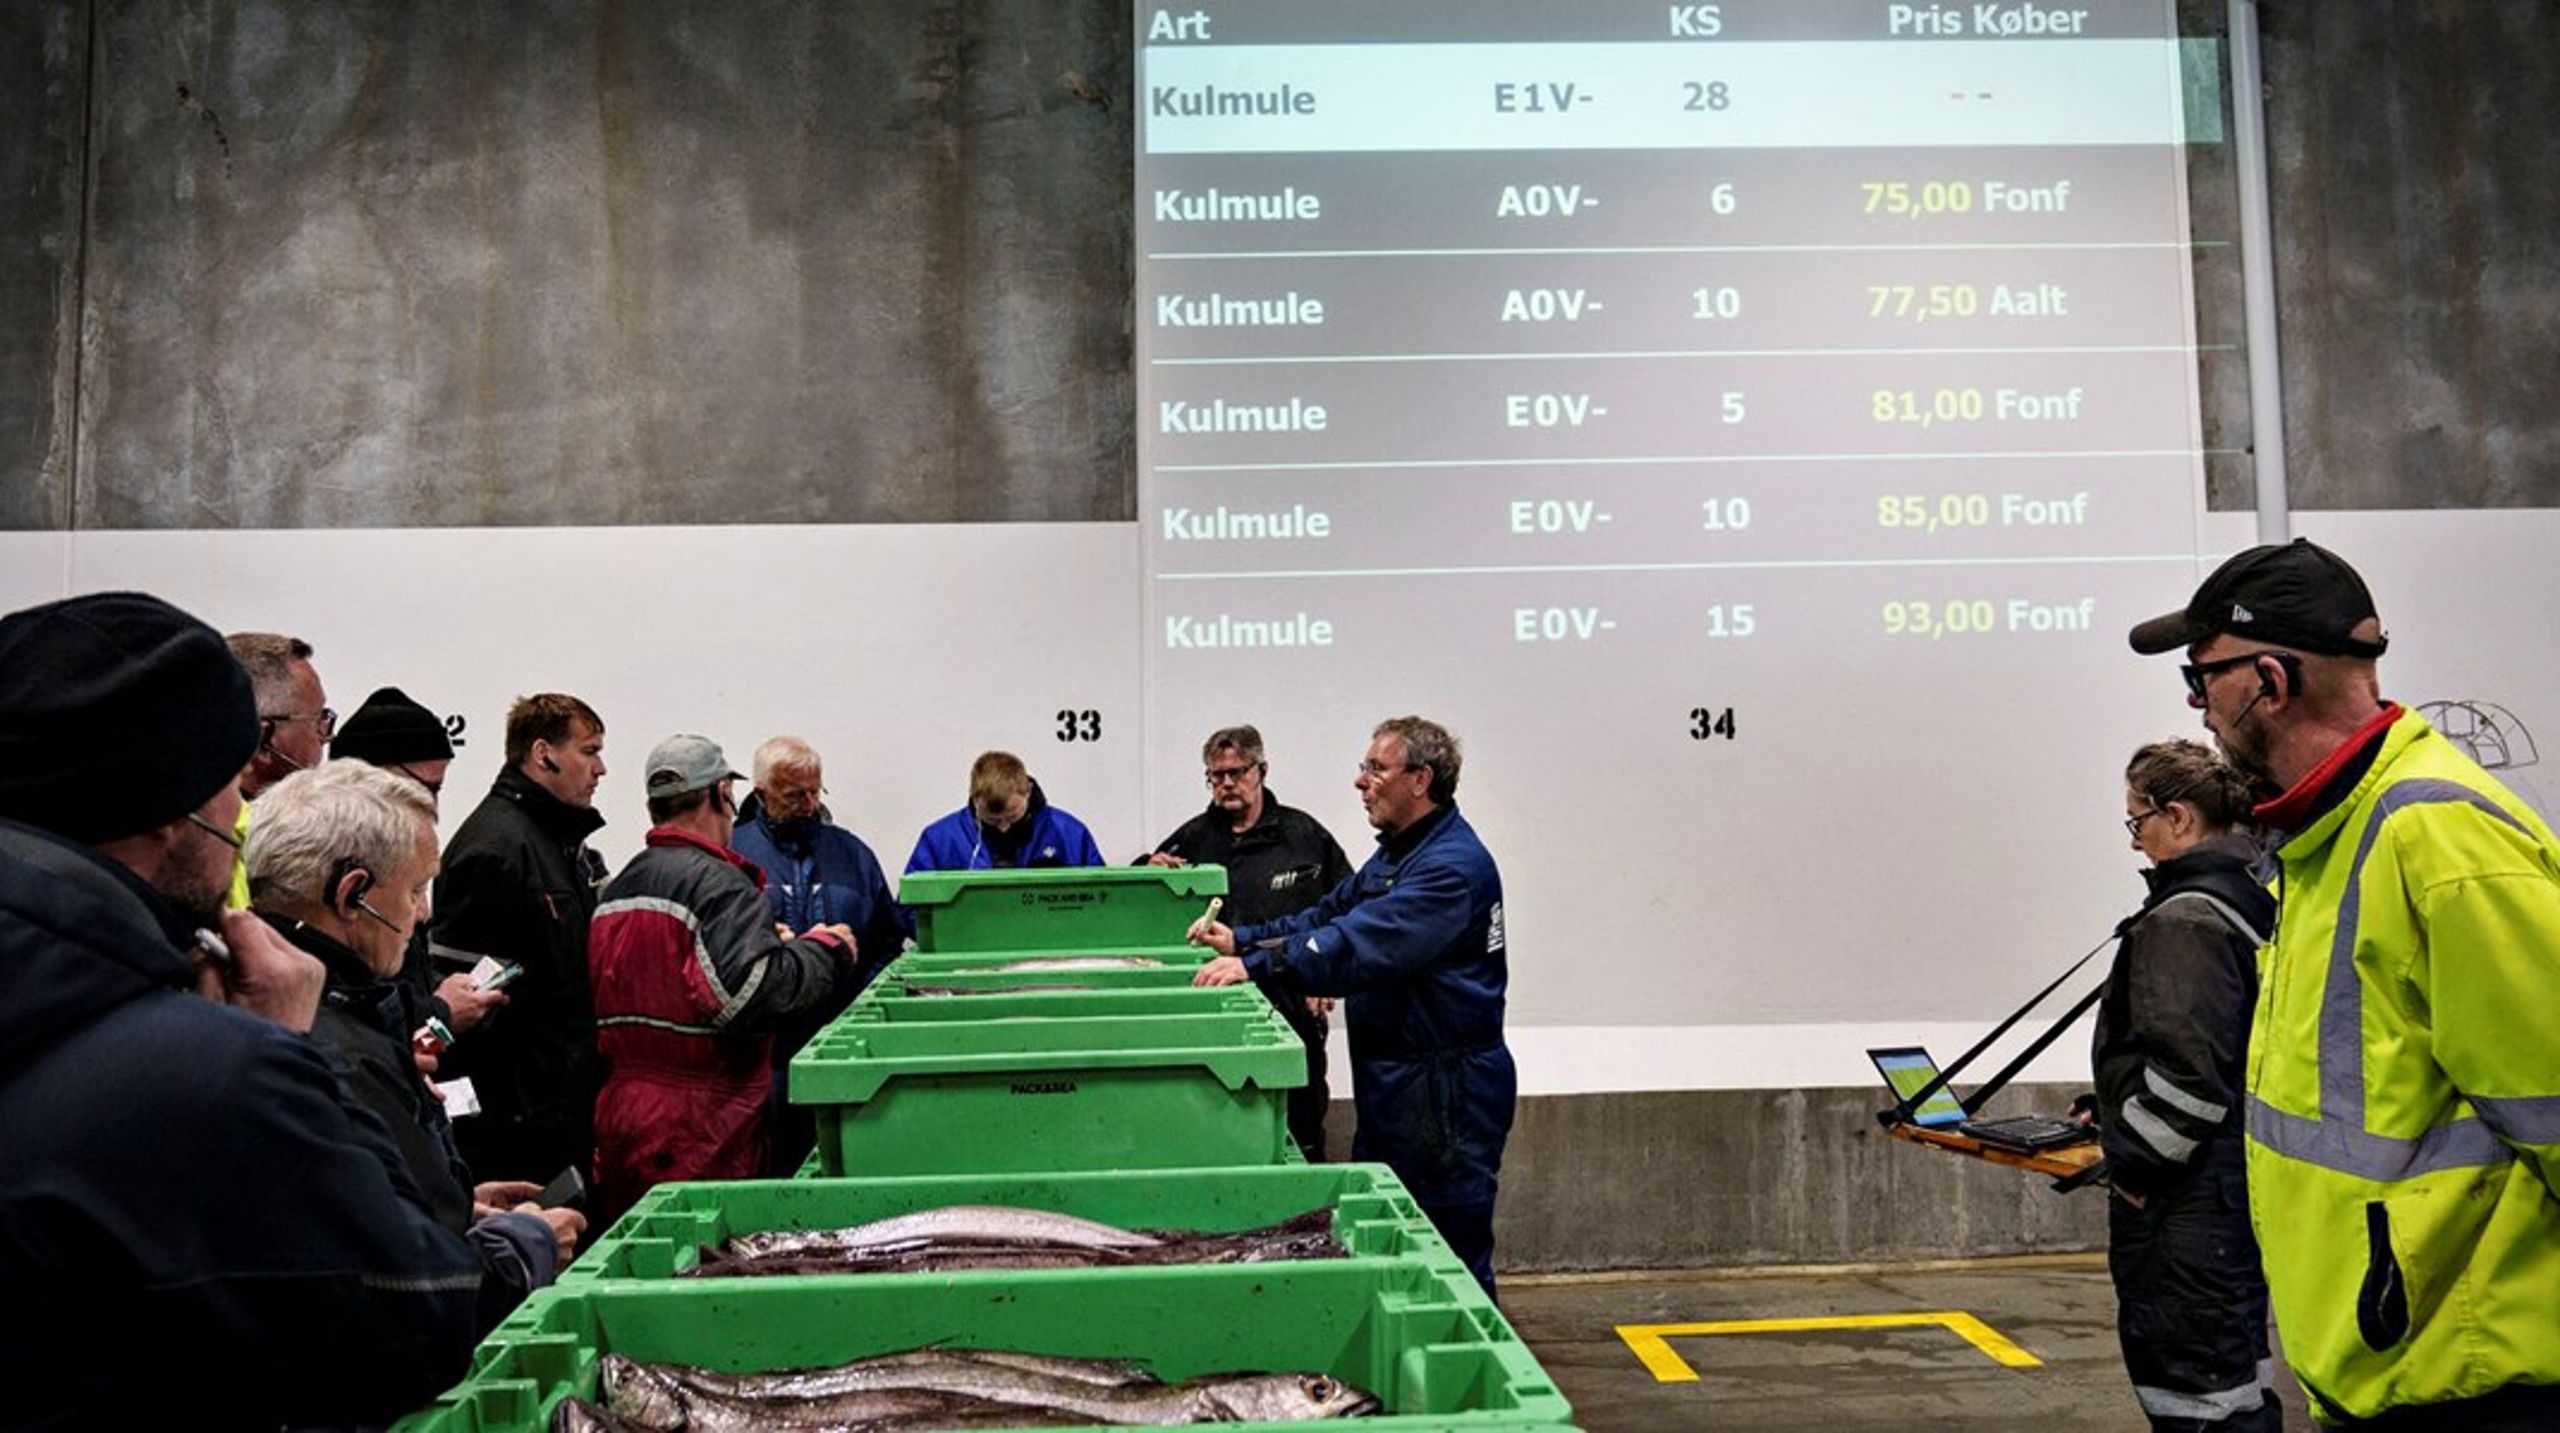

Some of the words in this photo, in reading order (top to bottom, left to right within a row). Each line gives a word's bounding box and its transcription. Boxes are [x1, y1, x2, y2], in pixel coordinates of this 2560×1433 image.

[1148, 9, 1211, 40] Art
[1670, 5, 1722, 36] KS
[1889, 4, 1962, 35] Pris
[1973, 2, 2088, 37] Køber
[1152, 83, 1315, 117] Kulmule
[1494, 82, 1593, 113] E1V-
[1683, 80, 1730, 111] 28
[1155, 187, 1320, 221] Kulmule
[1497, 185, 1599, 217] A0V-
[1711, 183, 1736, 215] 6
[1861, 180, 1972, 220] 75,00
[1983, 180, 2070, 212] Fonf
[1157, 291, 1324, 327] Kulmule
[1501, 289, 1603, 321] A0V-
[1693, 287, 1740, 319] 10
[1867, 285, 1977, 323] 77,50
[1989, 283, 2068, 316] Aalt
[1160, 397, 1327, 433] Kulmule
[1506, 394, 1607, 427] E0V-
[1722, 391, 1745, 424] 5
[1872, 388, 1983, 428] 81,00
[1996, 387, 2083, 420] Fonf
[1163, 504, 1330, 540] Kulmule
[1511, 500, 1612, 533] E0V-
[1702, 497, 1751, 530] 10
[1877, 494, 1989, 533] 85,00
[2001, 491, 2089, 525] Fonf
[1166, 612, 1333, 648] Kulmule
[1514, 607, 1616, 641] E0V-
[1707, 604, 1755, 637] 15
[1882, 599, 1995, 639] 93,00
[2007, 597, 2095, 631] Fonf
[446, 714, 465, 747] 2
[1056, 709, 1101, 742] 33
[1690, 707, 1735, 740] 34
